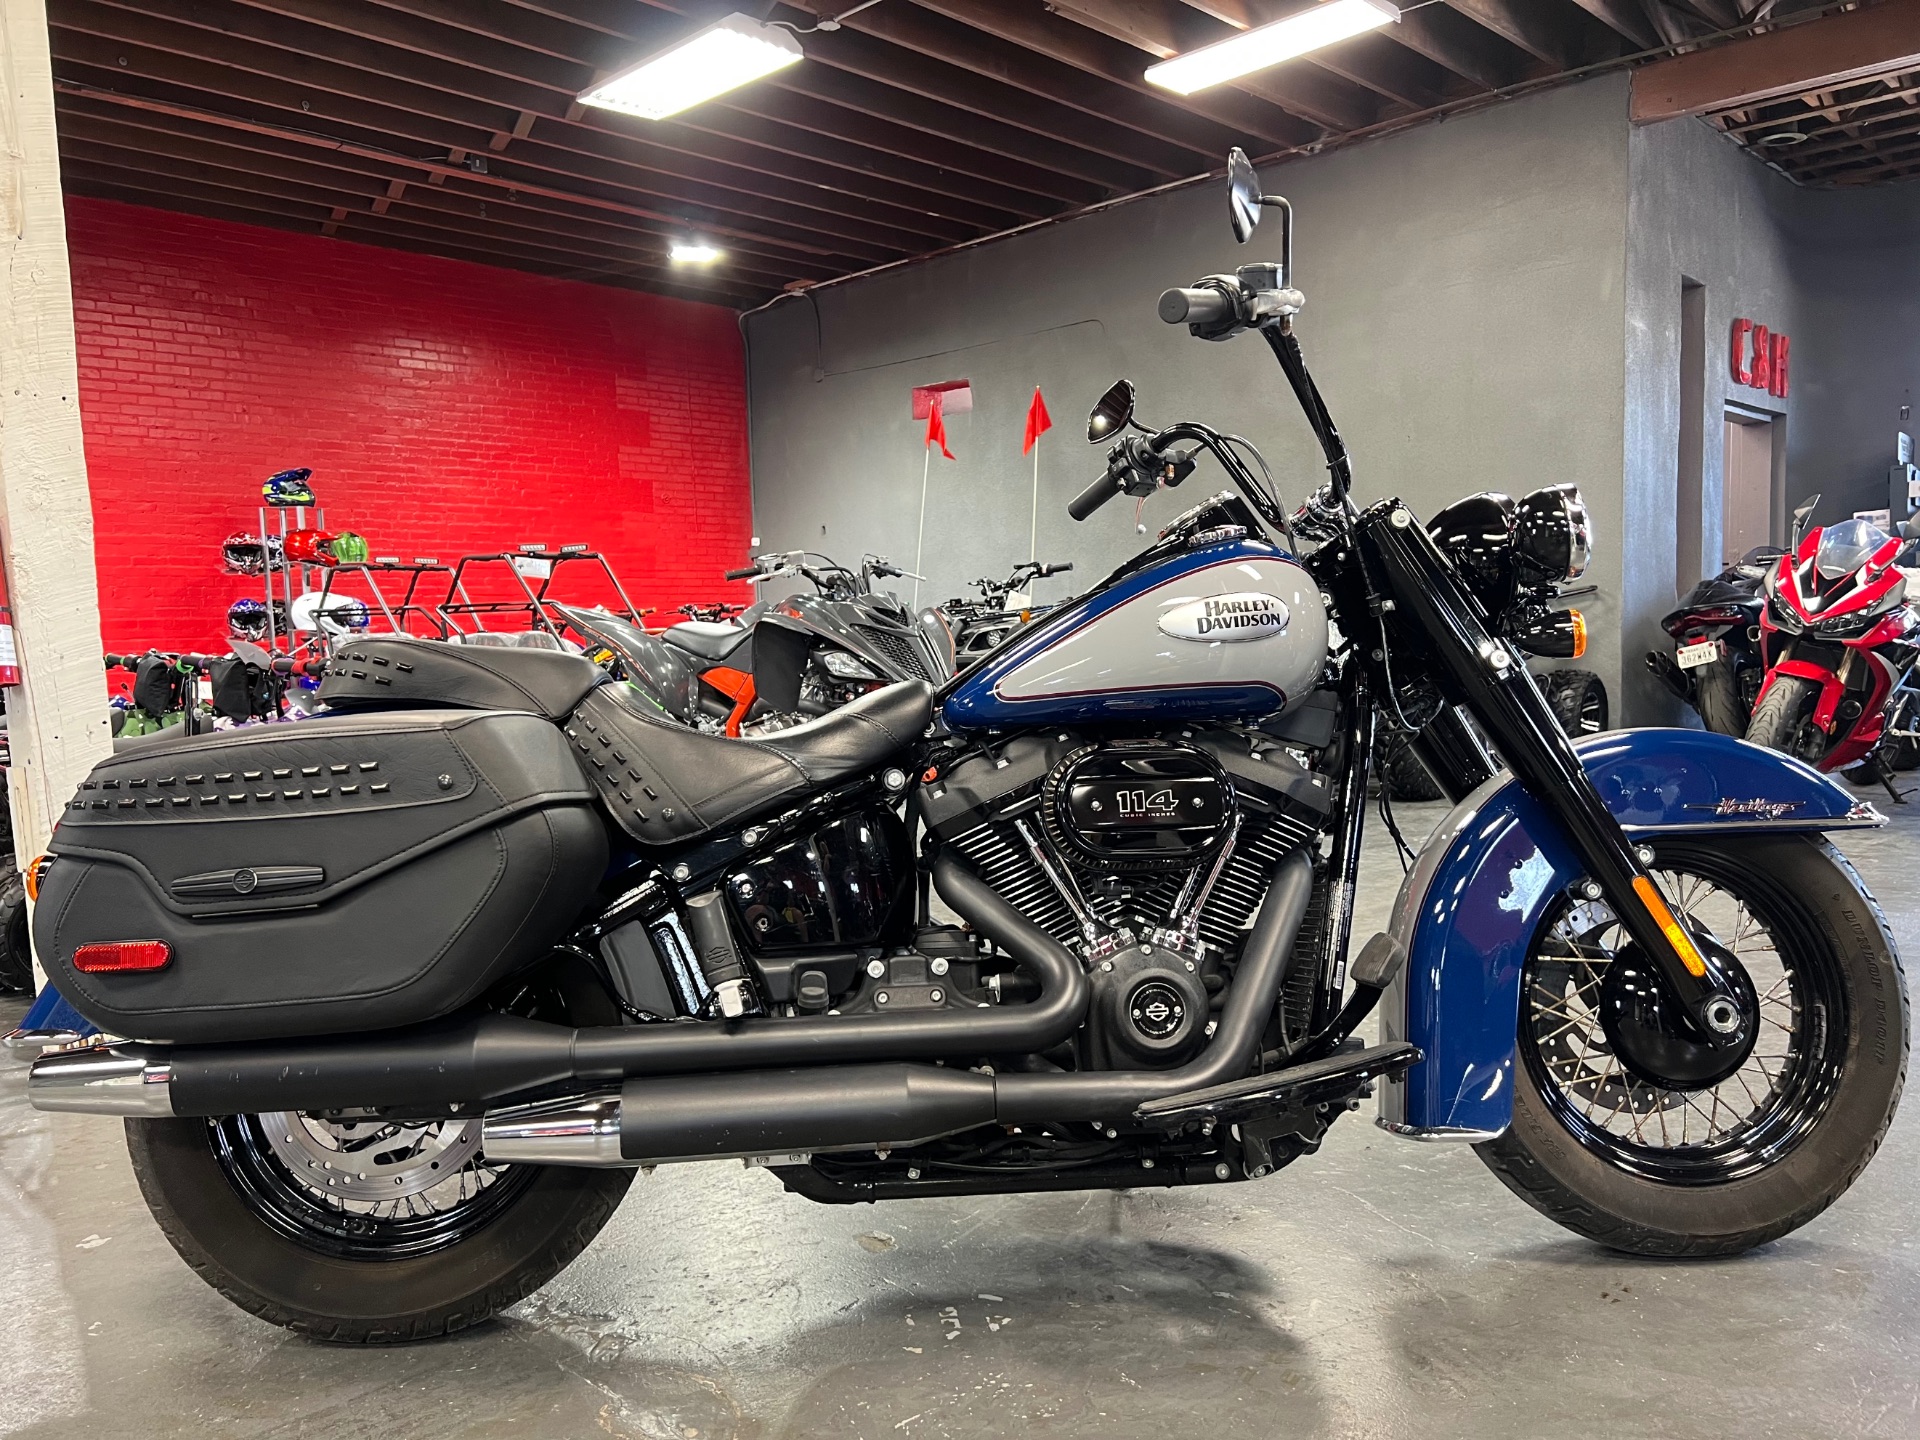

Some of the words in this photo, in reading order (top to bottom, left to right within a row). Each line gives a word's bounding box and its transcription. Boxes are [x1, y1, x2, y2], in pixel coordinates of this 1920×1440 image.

[1197, 613, 1281, 635] DAVIDSON
[1116, 789, 1179, 812] 114
[1841, 909, 1883, 992] DUNLOP
